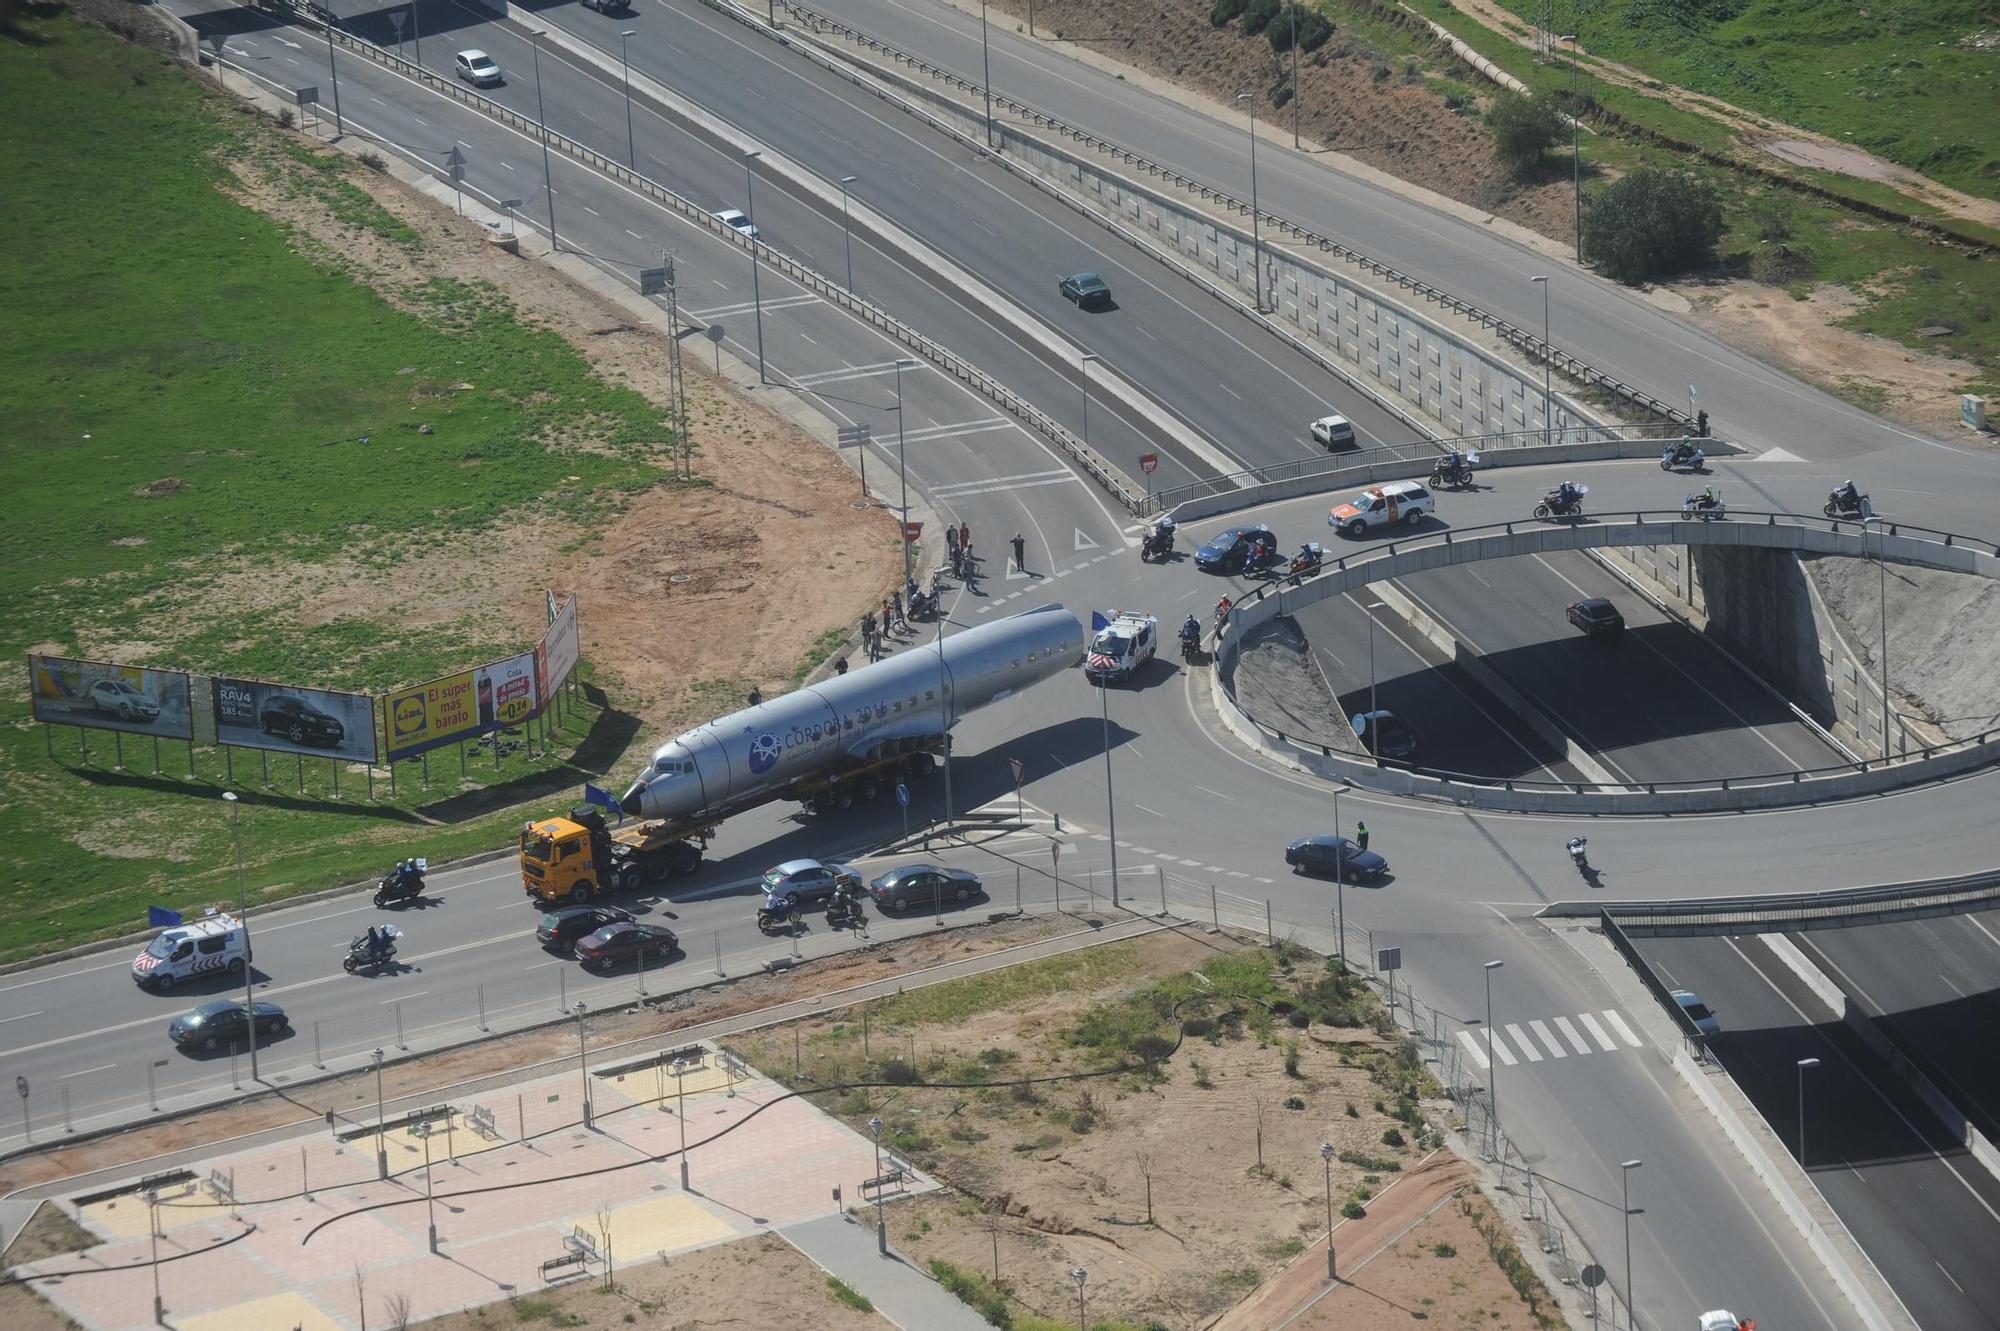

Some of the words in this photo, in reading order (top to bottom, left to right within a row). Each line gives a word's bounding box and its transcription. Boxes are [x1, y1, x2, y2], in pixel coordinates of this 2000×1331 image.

[507, 668, 522, 678] Cola
[220, 689, 251, 703] RAV4
[428, 687, 439, 703] El
[442, 681, 472, 699] súper
[440, 699, 462, 714] más
[856, 701, 888, 724] 2016
[435, 710, 469, 729] barato
